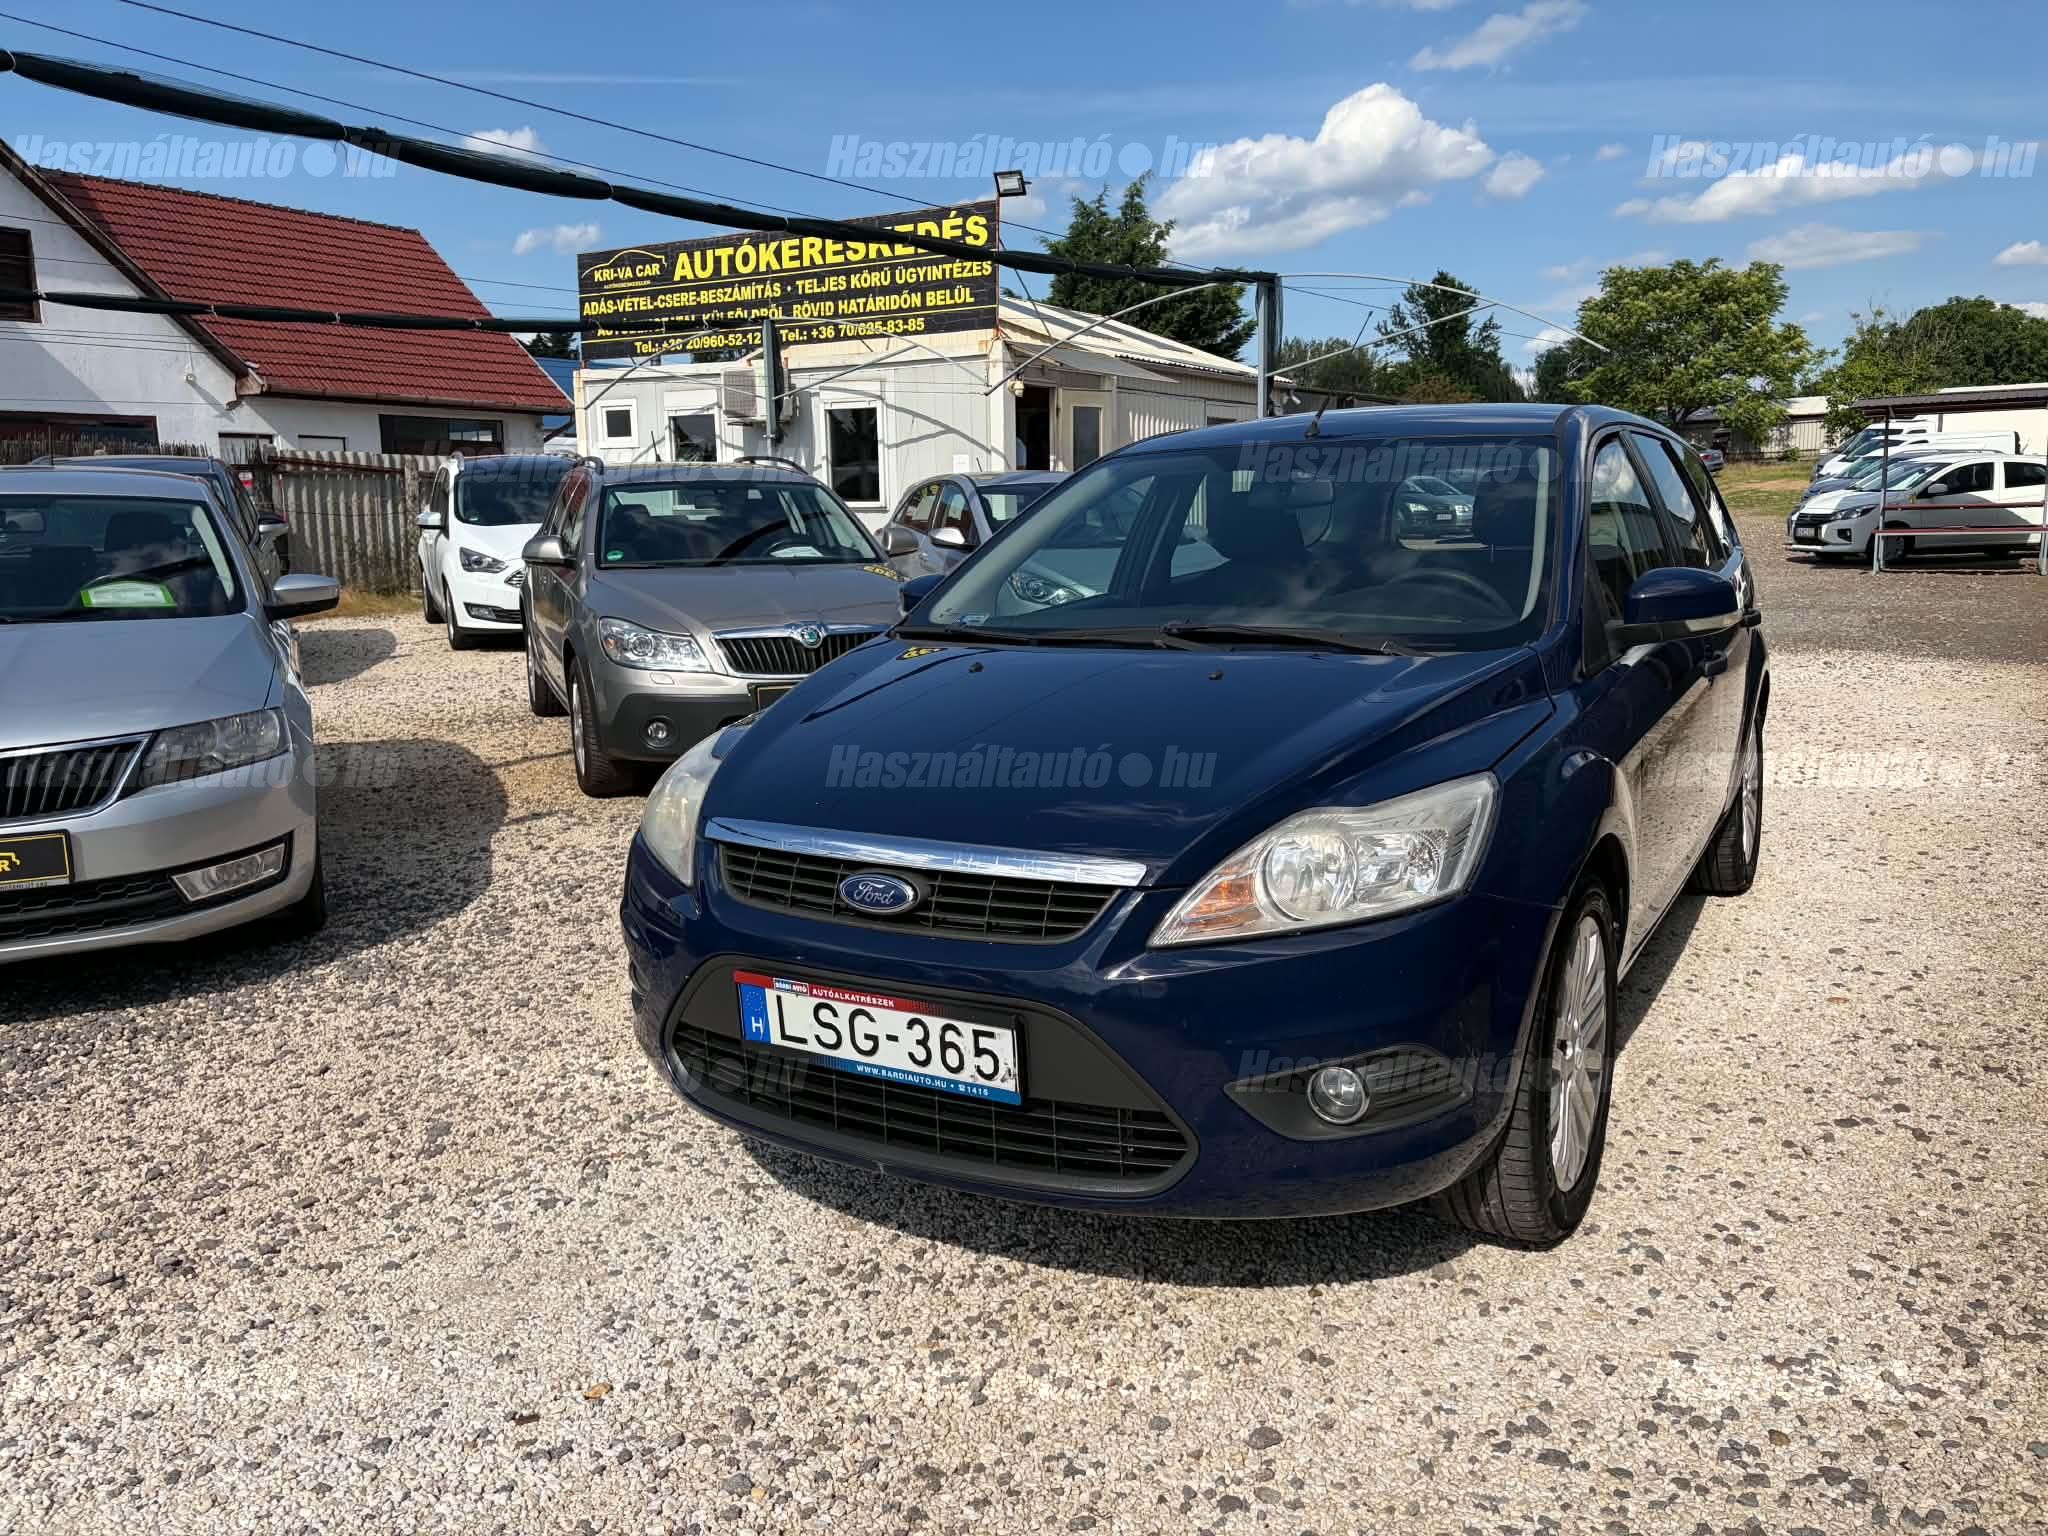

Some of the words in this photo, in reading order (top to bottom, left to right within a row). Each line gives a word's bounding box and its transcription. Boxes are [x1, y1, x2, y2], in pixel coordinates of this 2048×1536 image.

[673, 210, 988, 281] AUTÓKERESKEDÉS
[594, 266, 632, 282] KRI-VA
[635, 263, 661, 276] CAR
[796, 275, 847, 295] TELJES
[850, 267, 891, 289] KÖRŰ
[792, 300, 834, 319] RÖVID
[838, 292, 922, 315] HATÁRIDŐN
[926, 285, 975, 307] BELÜL
[780, 328, 807, 342] Tel.:
[811, 326, 835, 339] +36
[854, 881, 896, 904] Ford
[812, 988, 895, 1008] AUTÓALKATRÉSZEK
[751, 1015, 764, 1033] H
[776, 994, 1000, 1082] LSG-365
[856, 1064, 947, 1088] WWW.BARDIAUTO.HU
